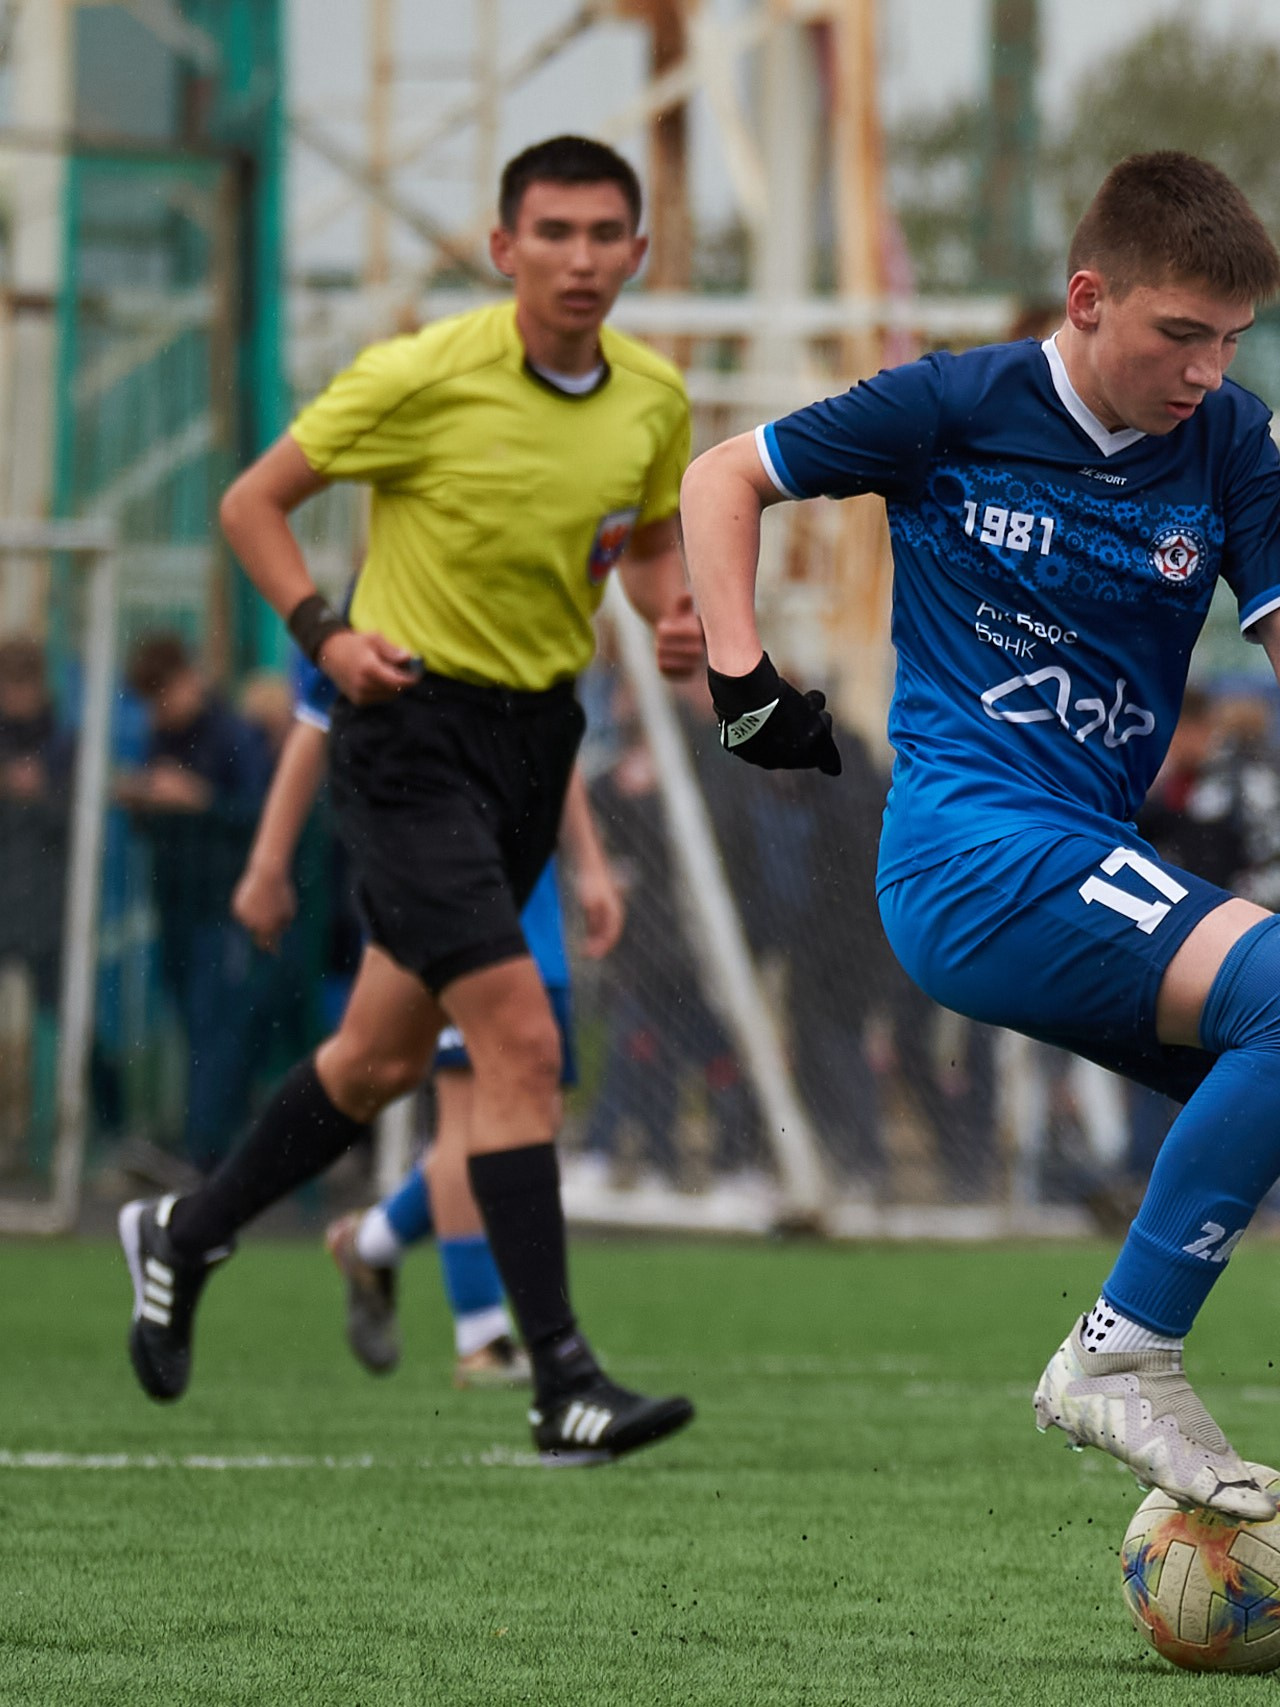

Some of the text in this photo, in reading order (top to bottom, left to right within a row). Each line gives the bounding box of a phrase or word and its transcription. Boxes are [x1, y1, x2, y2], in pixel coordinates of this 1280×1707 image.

[1094, 471, 1128, 486] SPORT
[963, 500, 1054, 556] 1981
[730, 715, 760, 739] NIKE
[1078, 846, 1190, 935] 17
